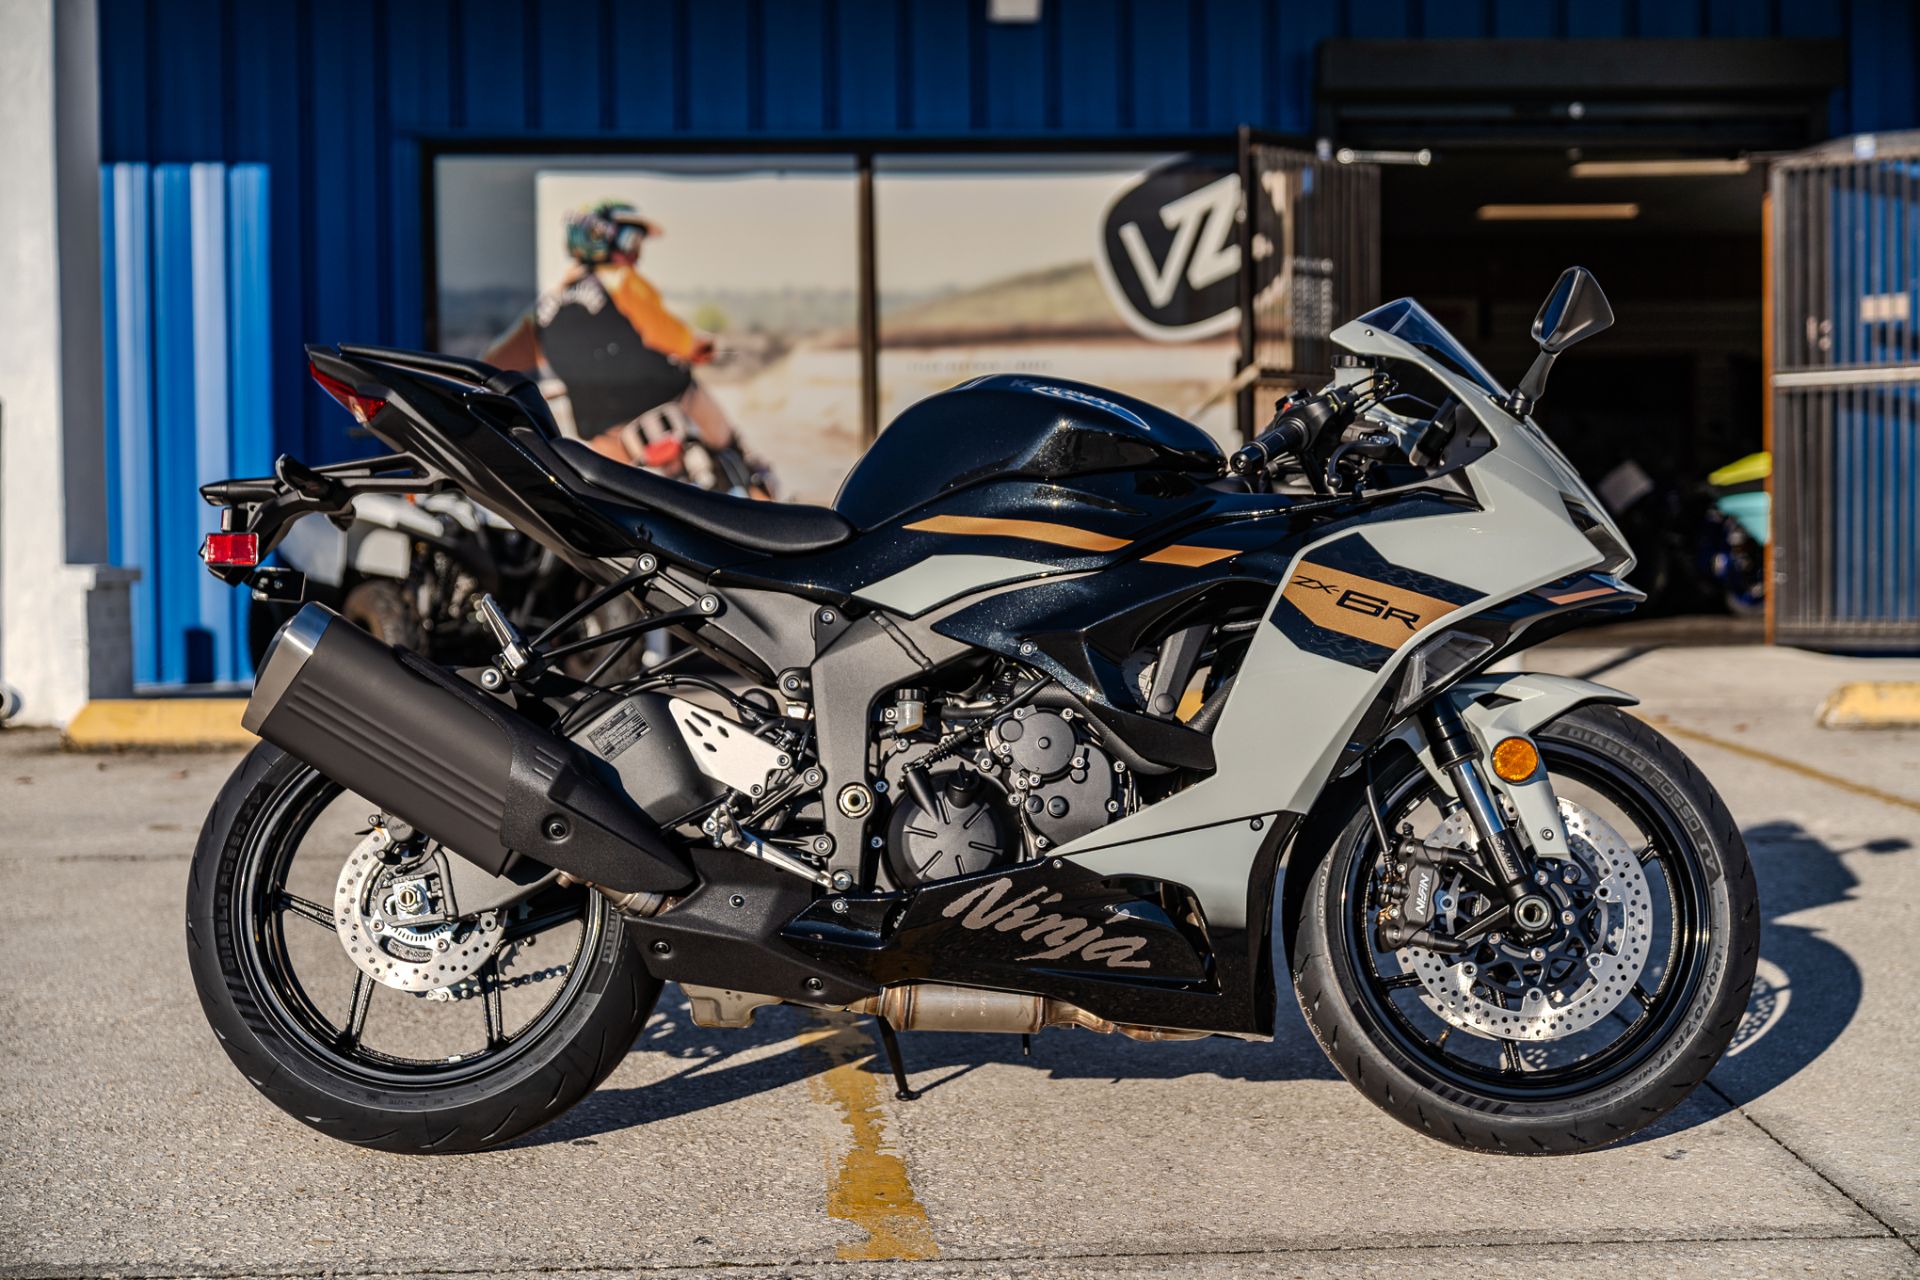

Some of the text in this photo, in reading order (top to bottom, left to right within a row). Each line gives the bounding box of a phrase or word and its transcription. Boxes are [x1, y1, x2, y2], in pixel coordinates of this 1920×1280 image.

[1568, 727, 1649, 771] DIABLO
[1649, 771, 1701, 832] ROSSO
[220, 823, 247, 886] ROSSO
[217, 893, 236, 970] DIABLO
[942, 877, 1150, 968] Ninja
[1694, 951, 1722, 1020] 120/70
